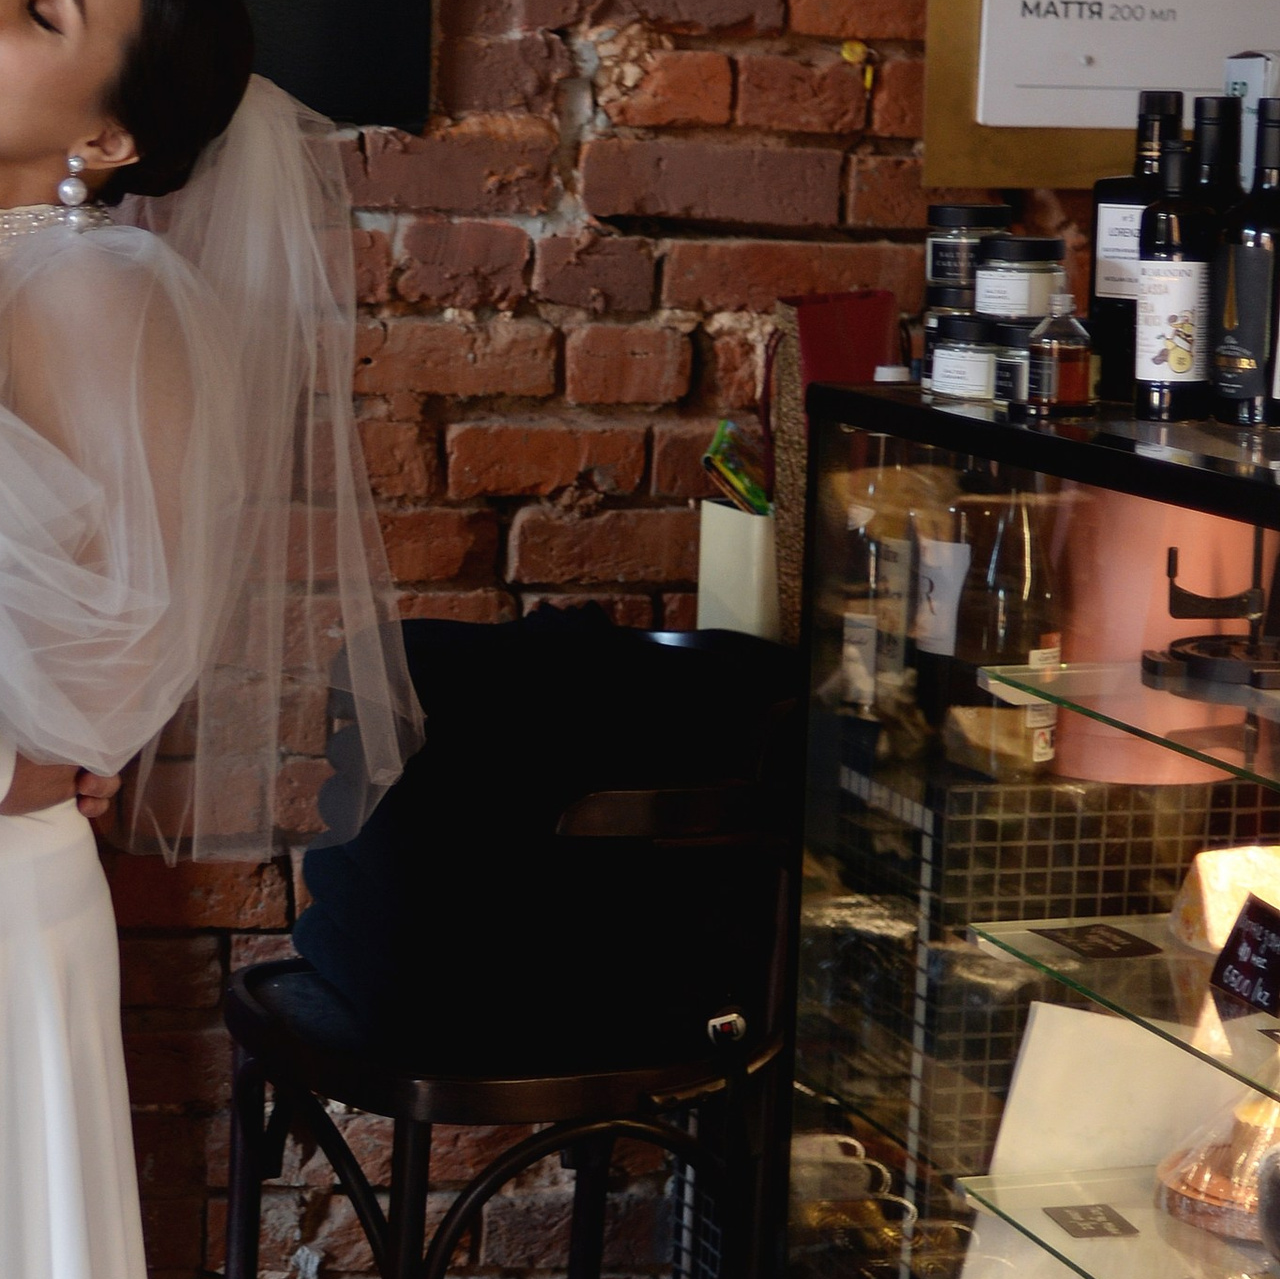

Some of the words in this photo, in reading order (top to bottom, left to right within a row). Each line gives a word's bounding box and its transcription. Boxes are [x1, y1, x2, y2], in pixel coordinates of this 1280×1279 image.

[1021, 0, 1103, 19] МАТТЯ
[1109, 4, 1146, 21] 200
[1150, 8, 1177, 21] мл
